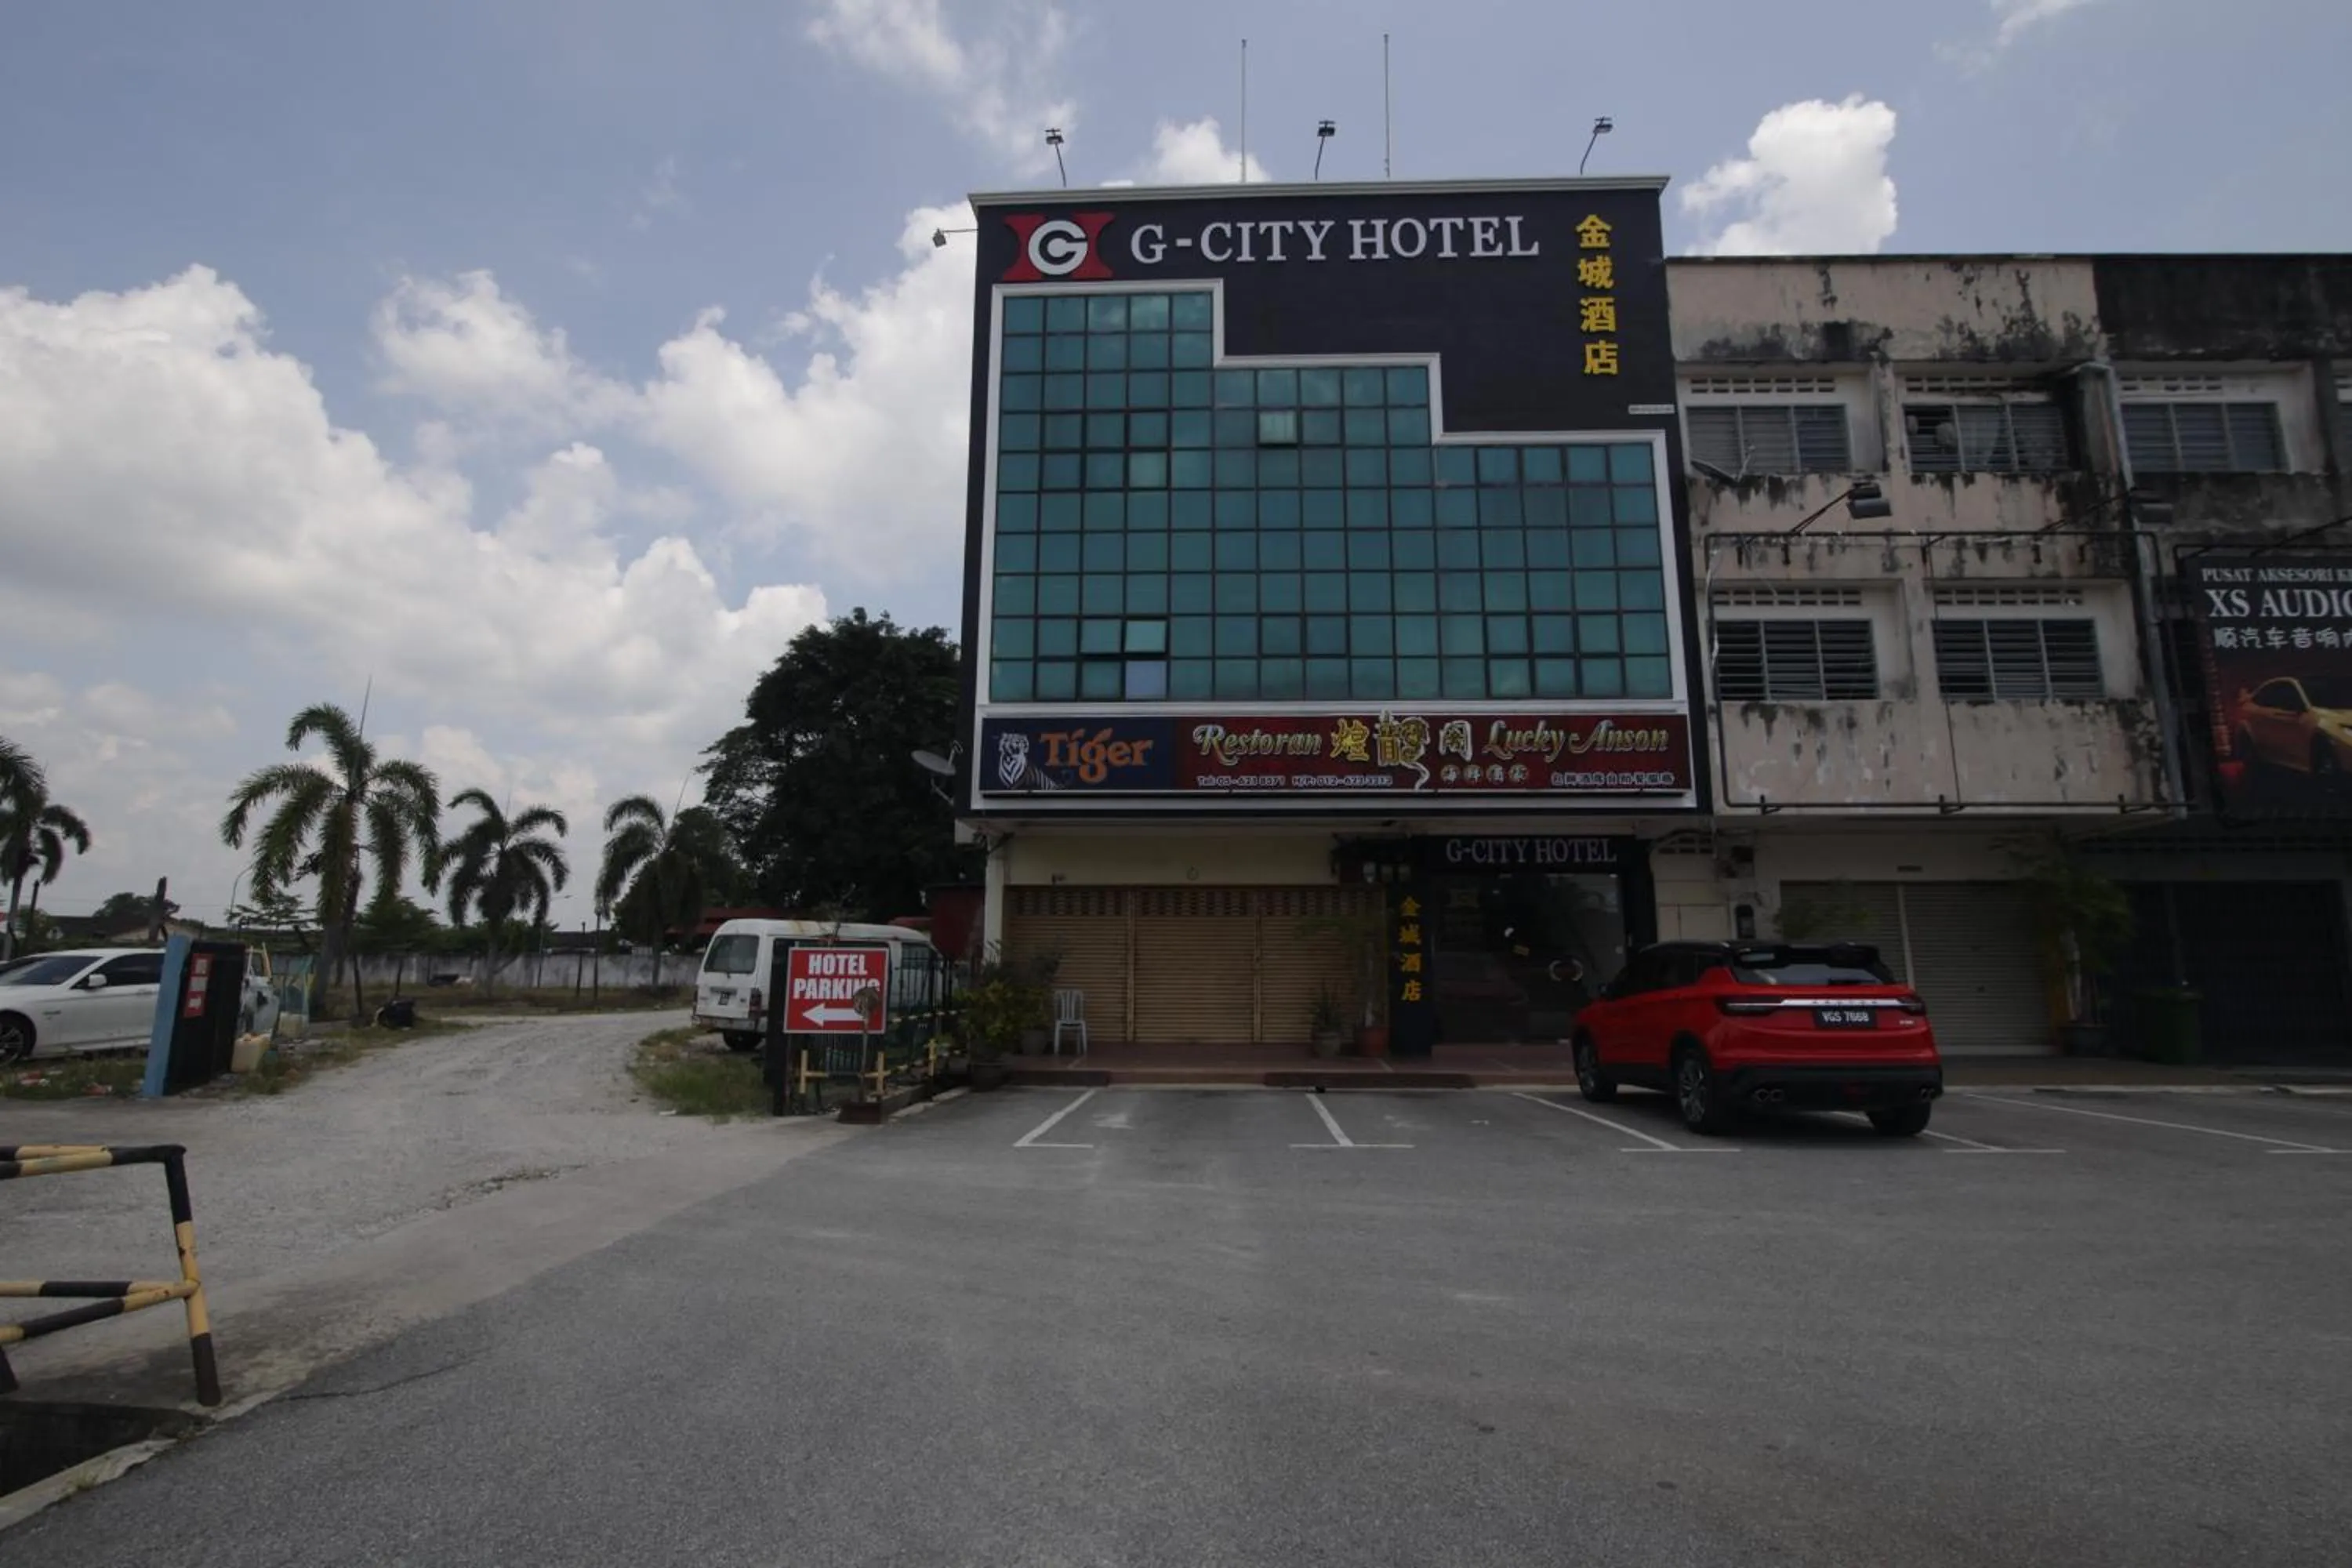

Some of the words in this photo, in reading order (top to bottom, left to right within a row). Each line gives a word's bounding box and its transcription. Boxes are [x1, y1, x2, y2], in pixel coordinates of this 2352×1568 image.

[1131, 220, 1335, 263] G-CITY
[1348, 216, 1540, 260] HOTEL
[1575, 213, 1619, 375] 金城酒店
[2201, 568, 2254, 583] PUSAT
[2257, 568, 2333, 583] AKSESORI
[2205, 589, 2252, 618] XS
[1039, 727, 1155, 783] Tiger
[1192, 724, 1323, 766] Restoran
[1480, 719, 1566, 764] Lucky
[1569, 719, 1670, 754] Anson
[1446, 839, 1530, 864] G-CITY
[1534, 837, 1617, 863] HOTEL
[808, 953, 868, 976] HOTEL
[1398, 895, 1422, 1001] 金城酒店
